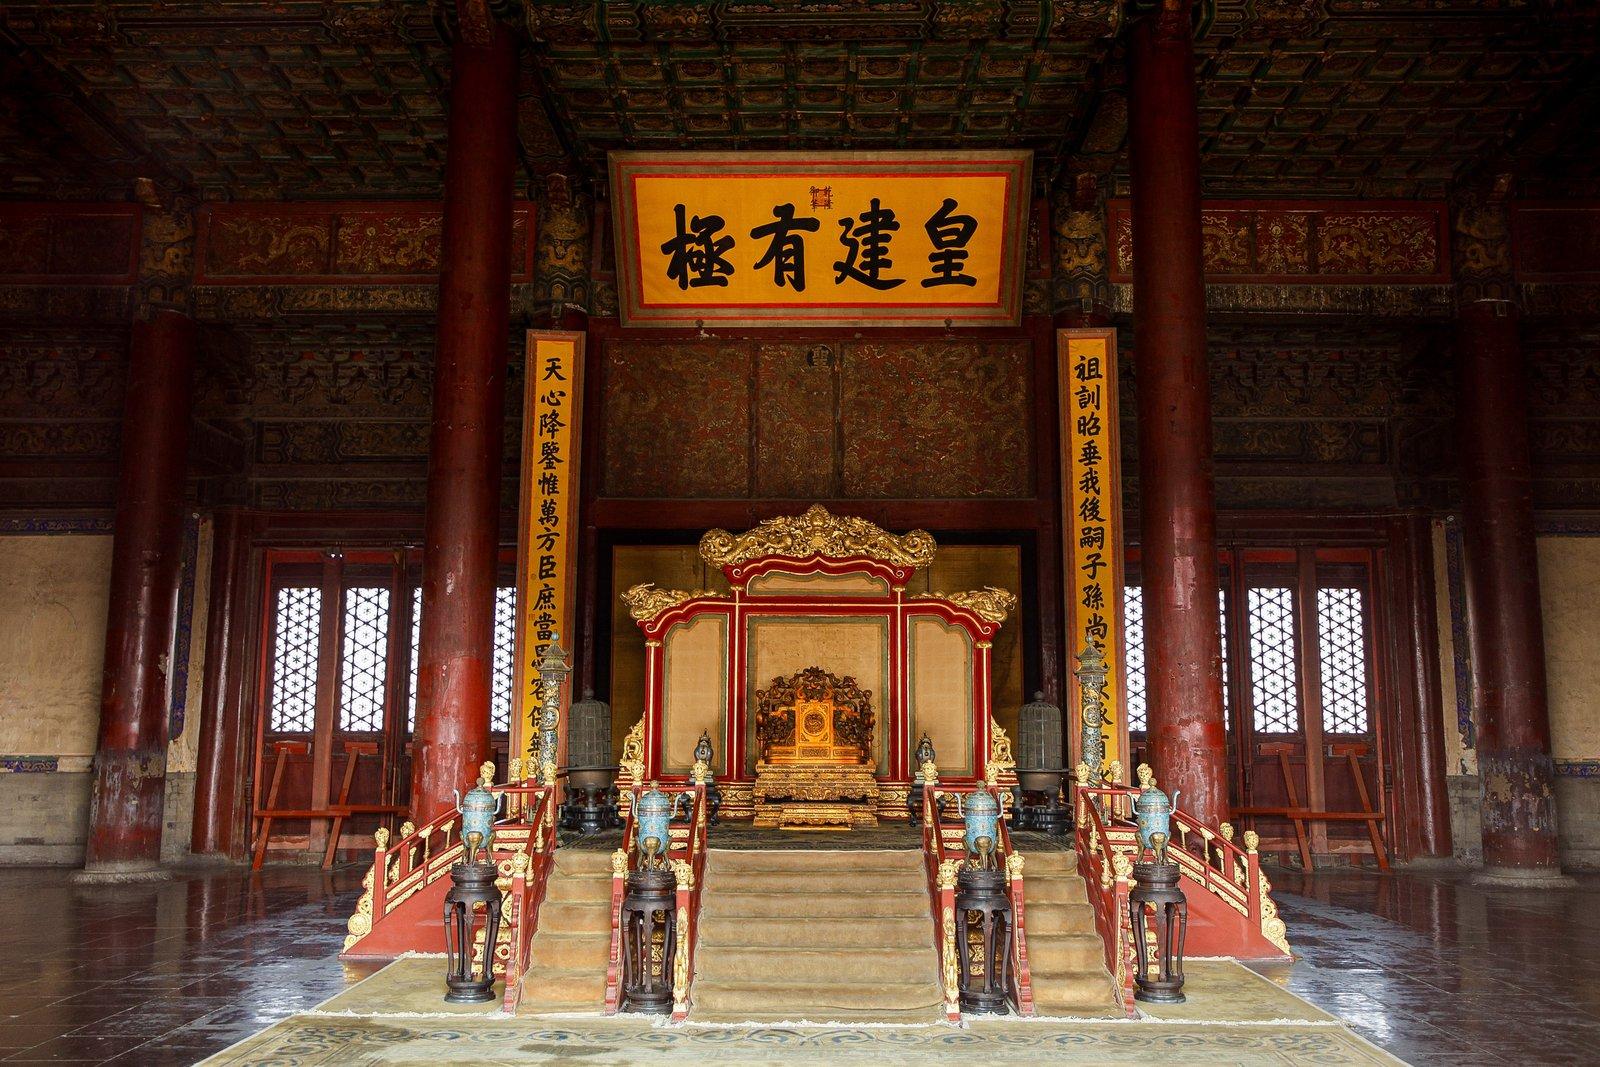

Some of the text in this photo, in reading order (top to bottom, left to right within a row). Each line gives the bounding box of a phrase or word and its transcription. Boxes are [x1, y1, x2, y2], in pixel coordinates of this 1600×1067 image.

[661, 197, 978, 292] 皇建有極
[1074, 355, 1113, 779] 祖訓昭垂我後嗣子孫尚
